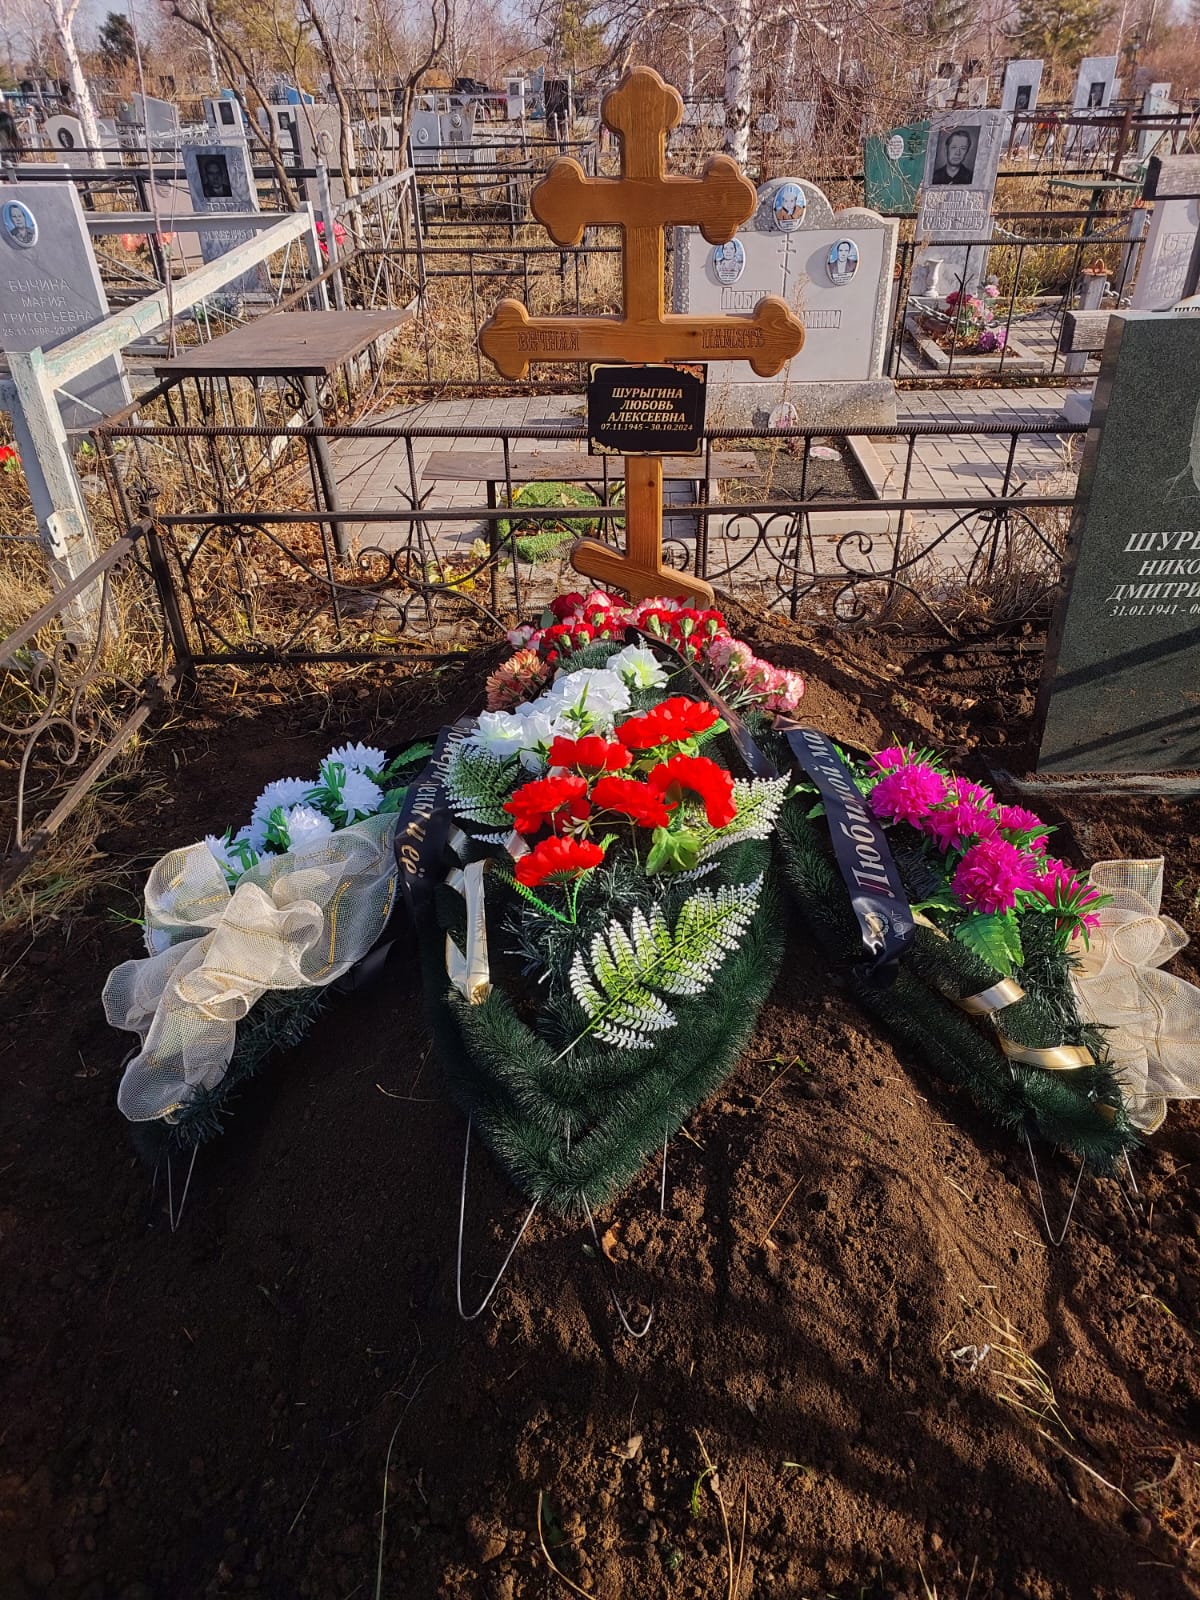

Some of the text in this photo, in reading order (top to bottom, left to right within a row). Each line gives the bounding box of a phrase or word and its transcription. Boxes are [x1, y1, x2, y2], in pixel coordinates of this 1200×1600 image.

[21, 296, 67, 308] МАРИЯ
[720, 287, 771, 310] Люби
[611, 387, 683, 399] ШУРЫГИНА
[620, 400, 674, 411] ЛЮБОВЬ
[607, 412, 685, 423] АЛЕКСЕЕВНА
[600, 423, 643, 431] 07.11.1945
[650, 423, 693, 431] 30.10.2024
[1137, 558, 1200, 576] НИКО
[1109, 604, 1178, 617] 31.01.1941
[811, 763, 896, 898] Любимой
[401, 843, 425, 878] её
